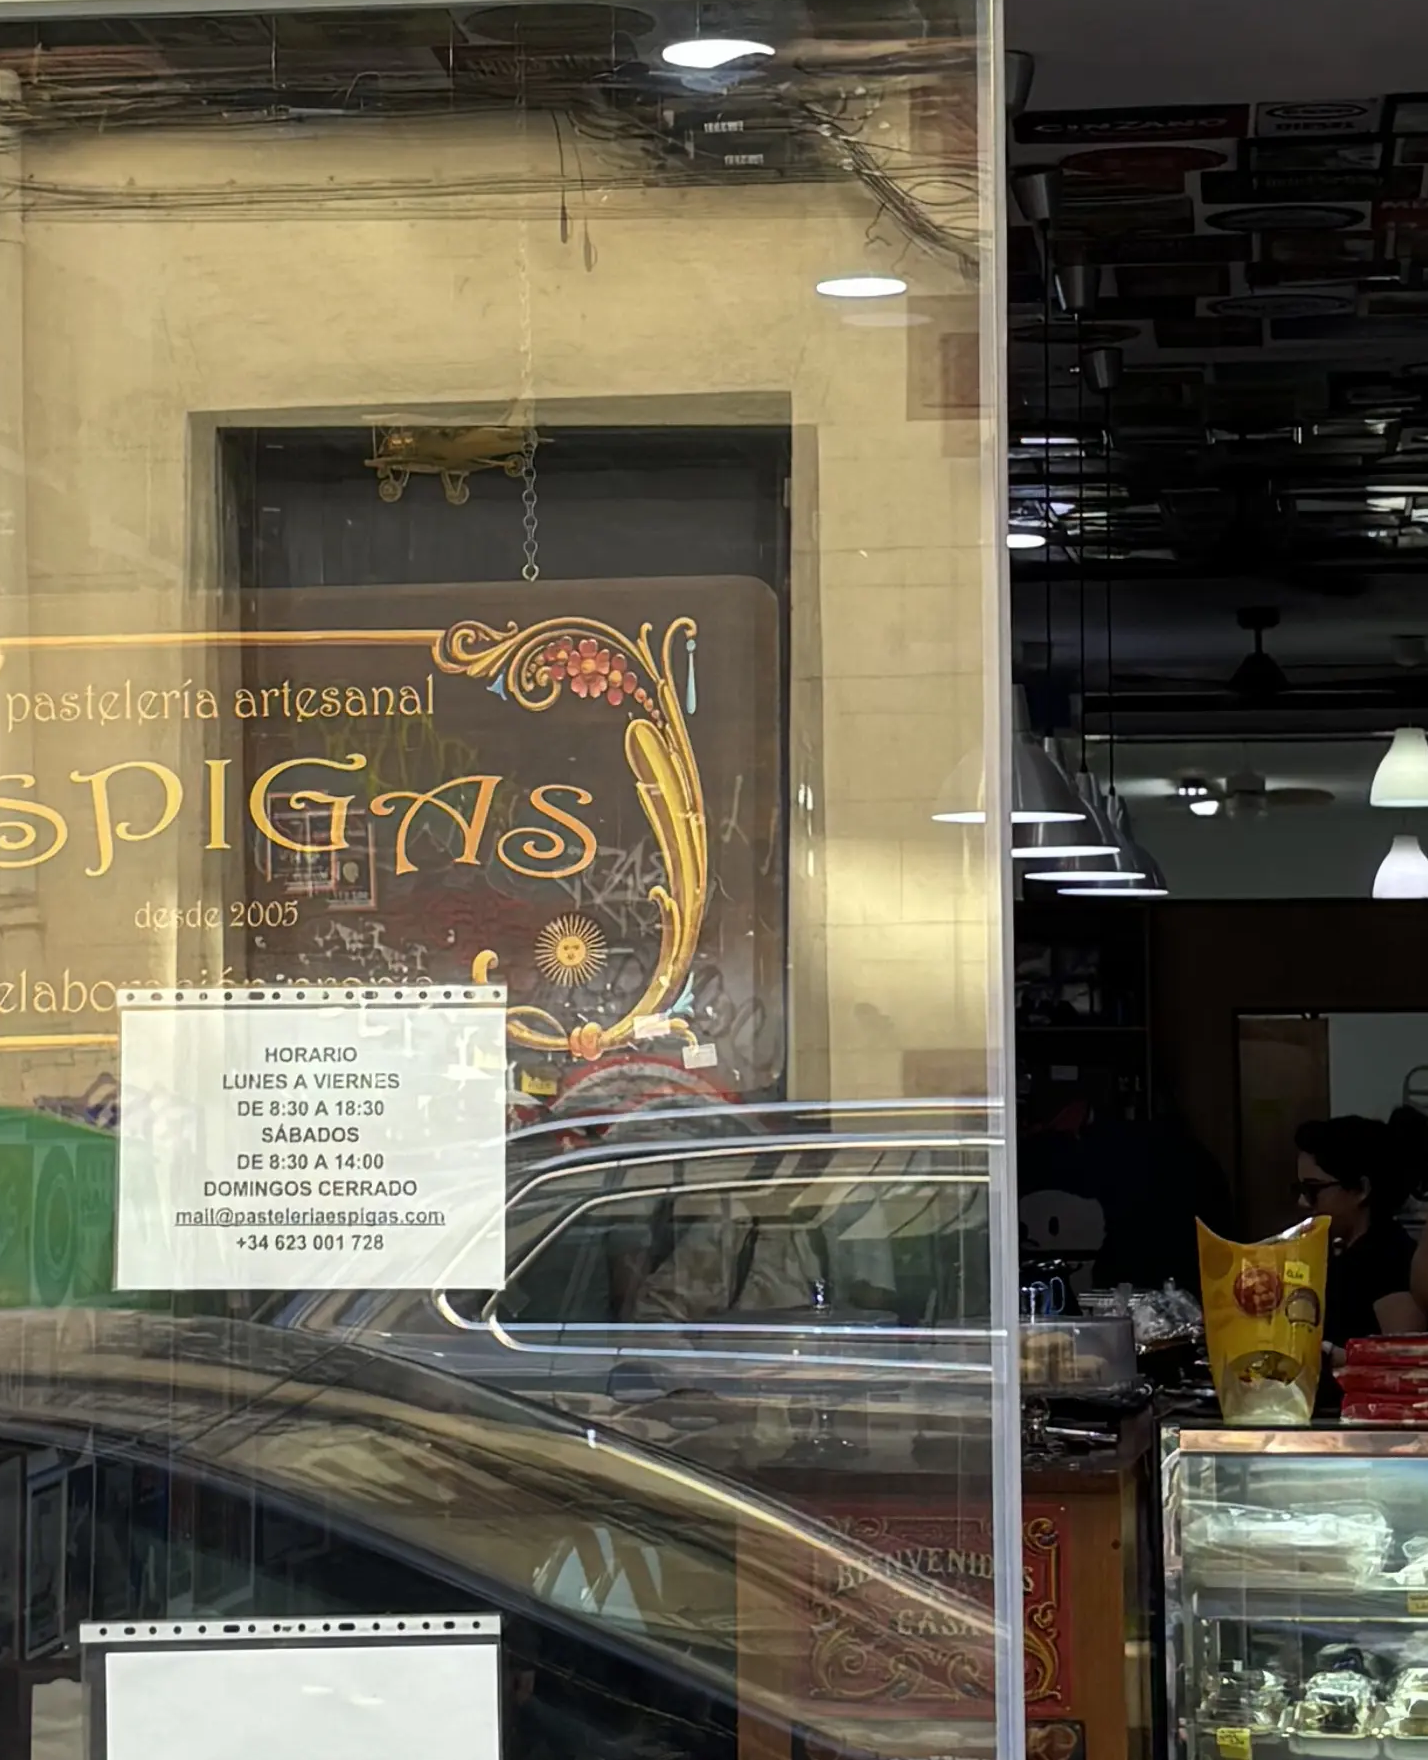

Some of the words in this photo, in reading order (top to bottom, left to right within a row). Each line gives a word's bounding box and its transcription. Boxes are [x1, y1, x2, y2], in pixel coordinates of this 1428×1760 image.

[4, 677, 220, 733] pastelería
[232, 672, 436, 725] artesanal
[133, 898, 220, 933] desde
[229, 897, 300, 933] 2005
[264, 1046, 358, 1064] HORARIO
[222, 1073, 288, 1091] LUNES
[293, 1073, 308, 1091] A
[314, 1072, 401, 1090] VIERNES
[237, 1099, 264, 1117] DE
[269, 1099, 309, 1117] 8:30
[314, 1099, 329, 1117] A
[334, 1099, 386, 1117] 18:30
[260, 1123, 361, 1144] SÁBADOS
[236, 1153, 264, 1171] DE
[269, 1153, 308, 1171] 8:30
[314, 1153, 329, 1171] A
[334, 1153, 385, 1171] 14:00
[203, 1180, 313, 1198] DOMINGOS
[318, 1180, 418, 1198] CERRADO
[174, 1207, 446, 1227] mail@pasteleriaespigas.com
[235, 1234, 270, 1252] +34
[274, 1234, 308, 1252] 623
[312, 1234, 345, 1252] 001
[350, 1234, 385, 1252] 728
